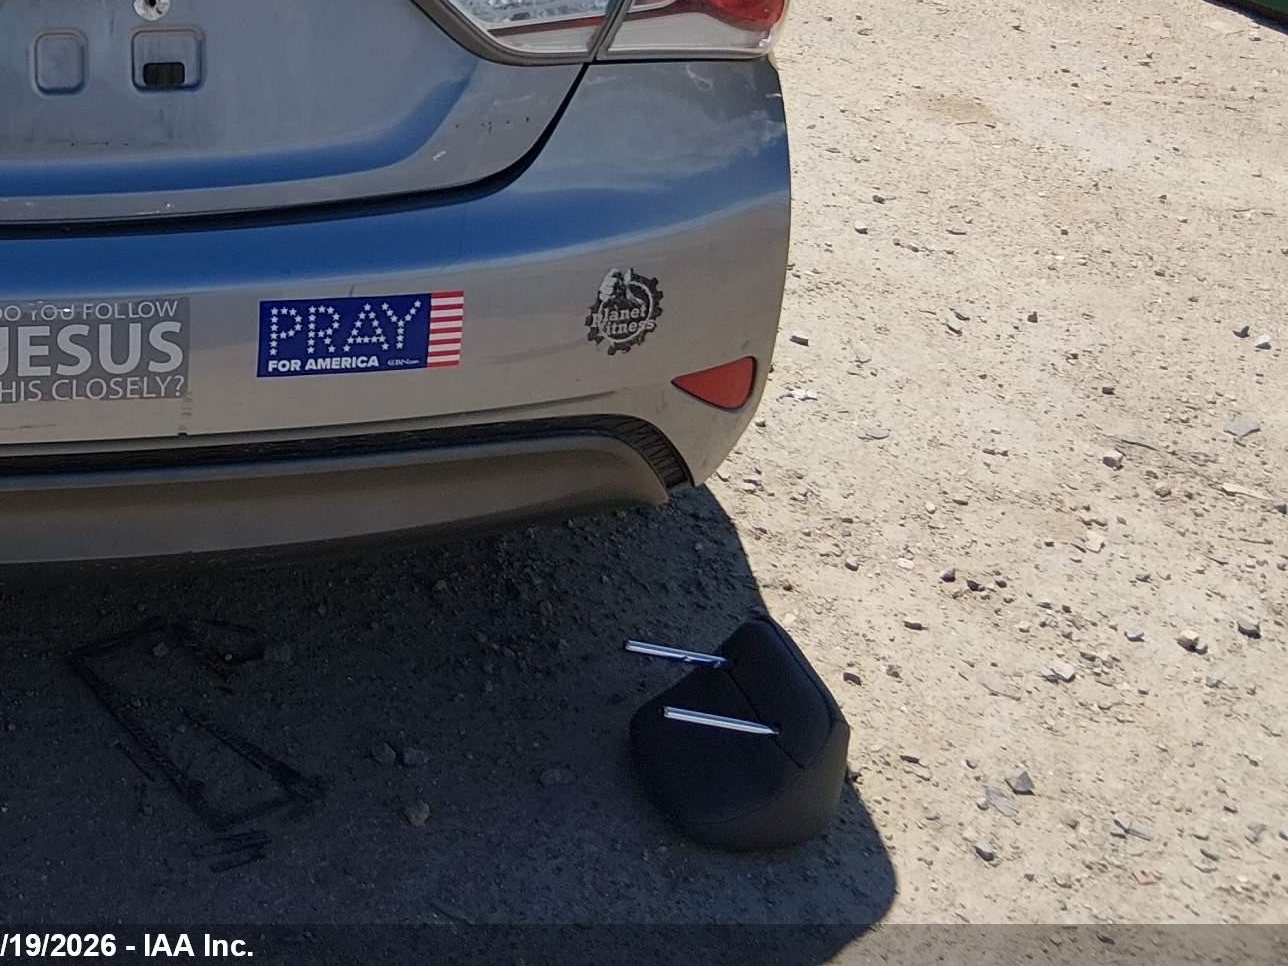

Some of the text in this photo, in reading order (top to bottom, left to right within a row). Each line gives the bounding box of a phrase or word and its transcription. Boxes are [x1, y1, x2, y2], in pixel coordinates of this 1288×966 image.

[30, 304, 75, 321] YOU
[83, 300, 179, 320] FOLLOW
[269, 300, 422, 356] PRAY
[268, 355, 380, 372] FOR AMERICA
[51, 375, 185, 401] CLOSELY?
